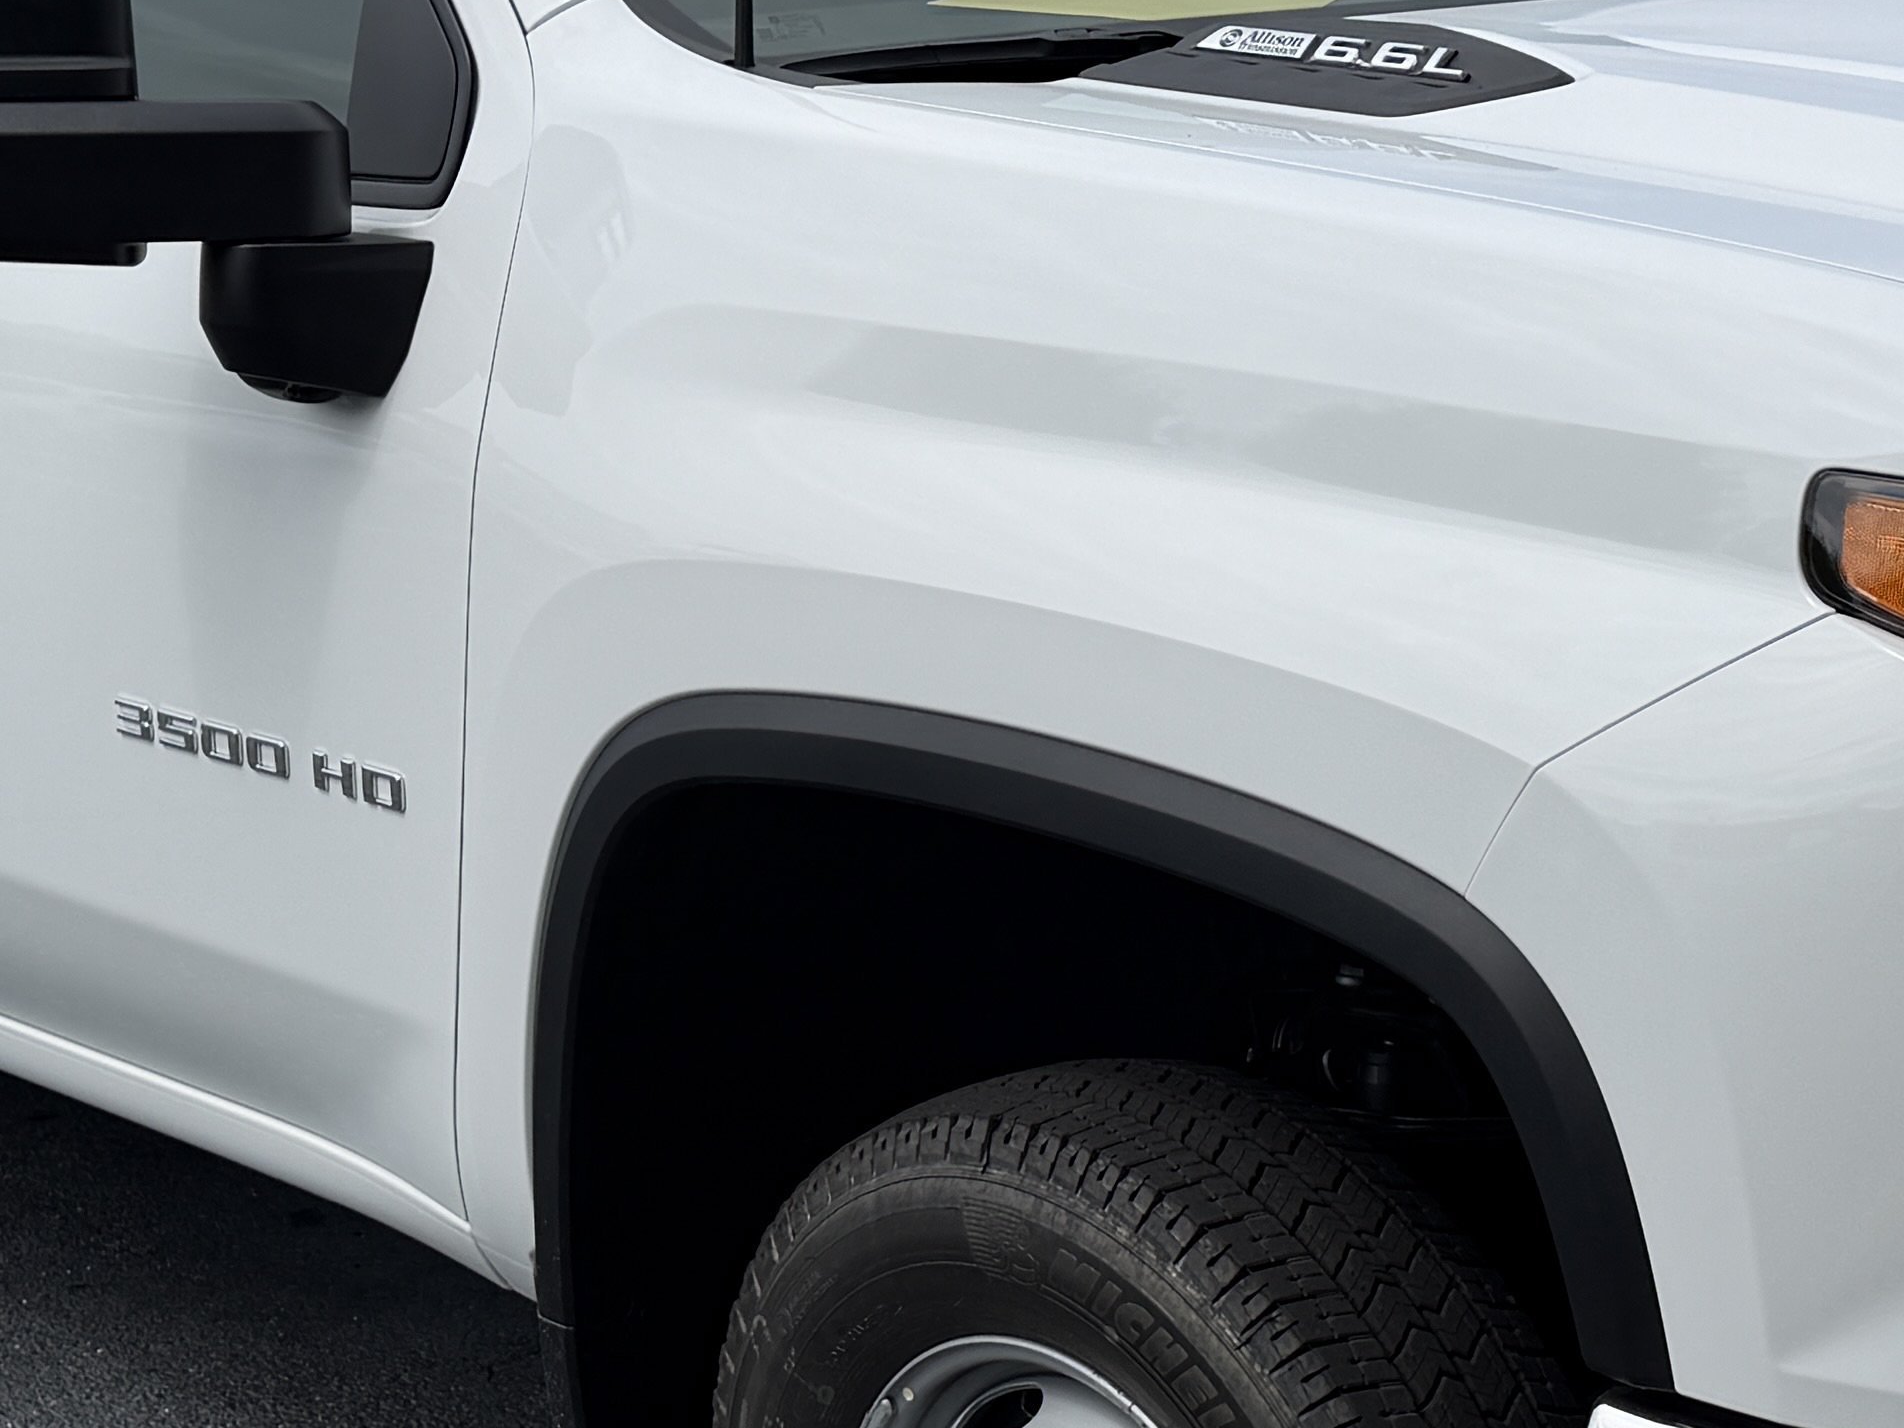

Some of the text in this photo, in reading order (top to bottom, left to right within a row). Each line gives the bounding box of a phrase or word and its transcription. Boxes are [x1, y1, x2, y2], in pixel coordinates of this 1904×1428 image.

[1241, 30, 1305, 48] Allison
[113, 694, 407, 815] 3500 HD
